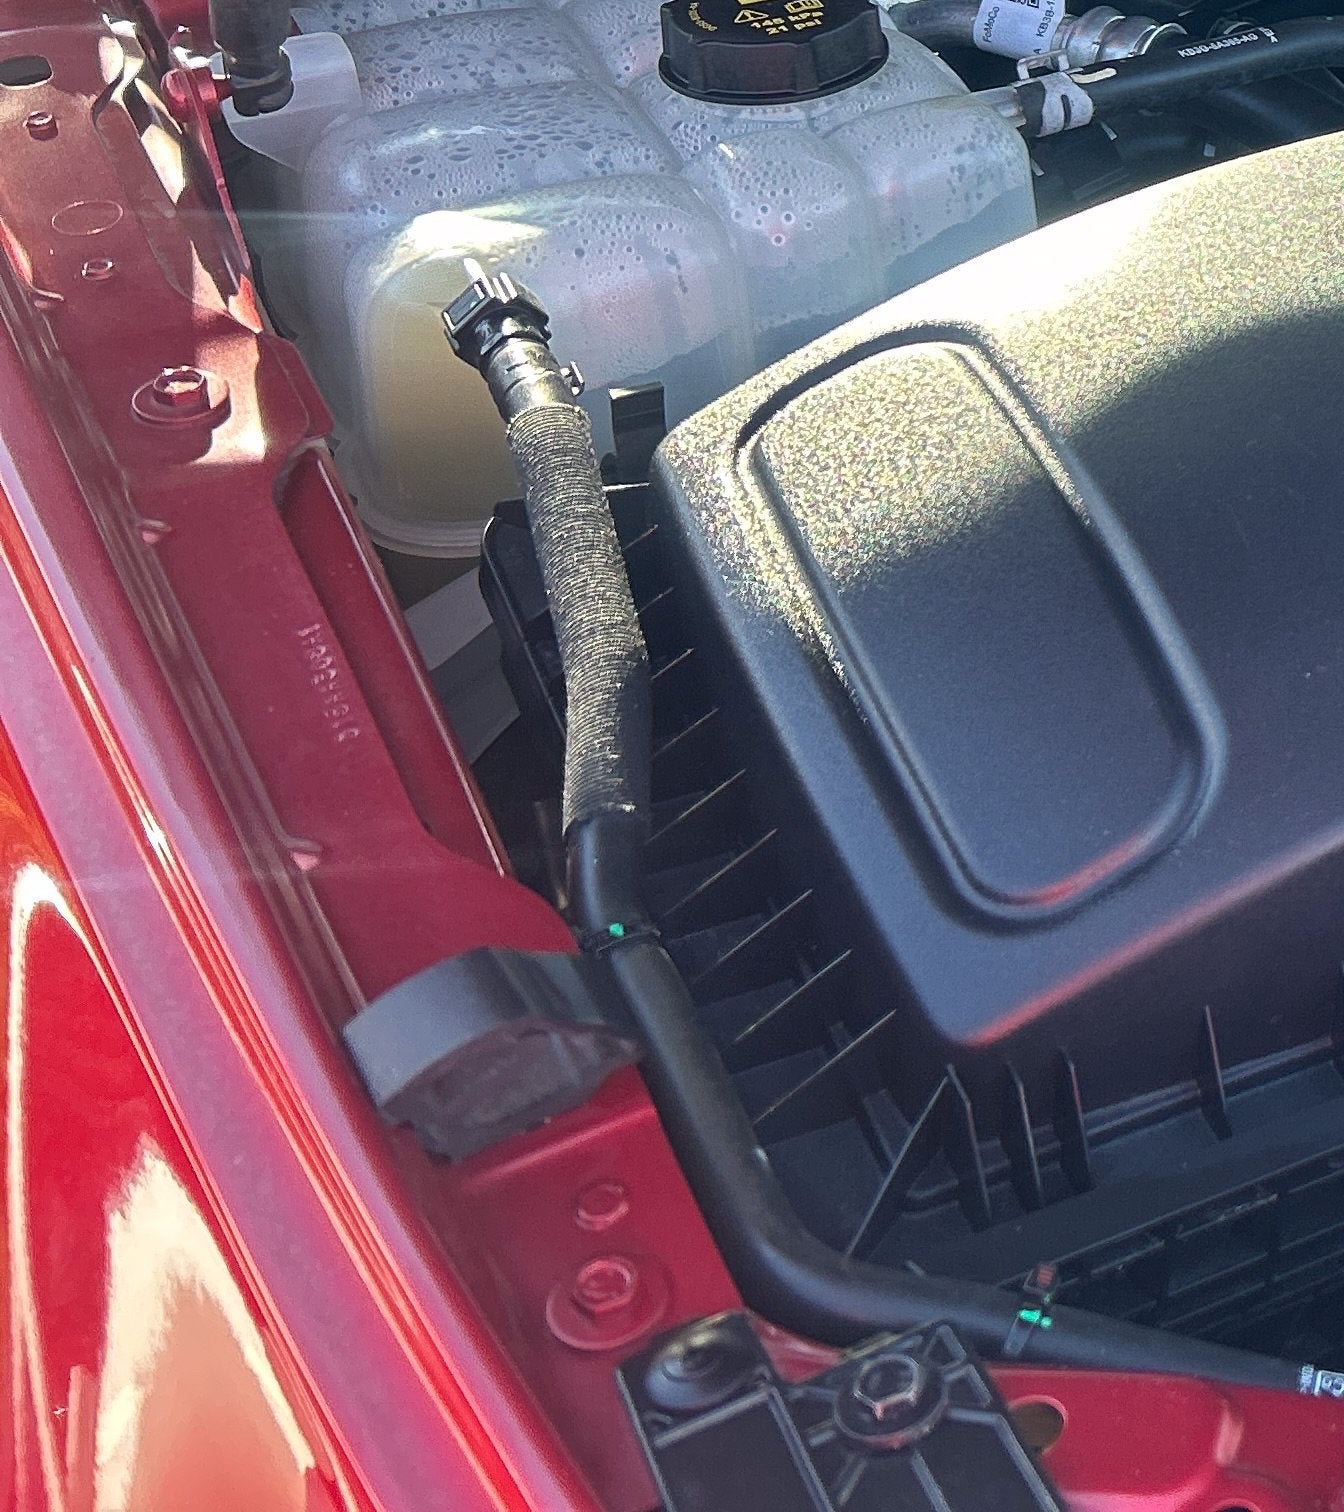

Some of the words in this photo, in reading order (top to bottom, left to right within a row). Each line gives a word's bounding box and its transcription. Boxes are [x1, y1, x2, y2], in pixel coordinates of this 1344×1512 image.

[768, 25, 788, 35] 21
[794, 19, 822, 30] psi
[982, 6, 1000, 43] FoMoCo
